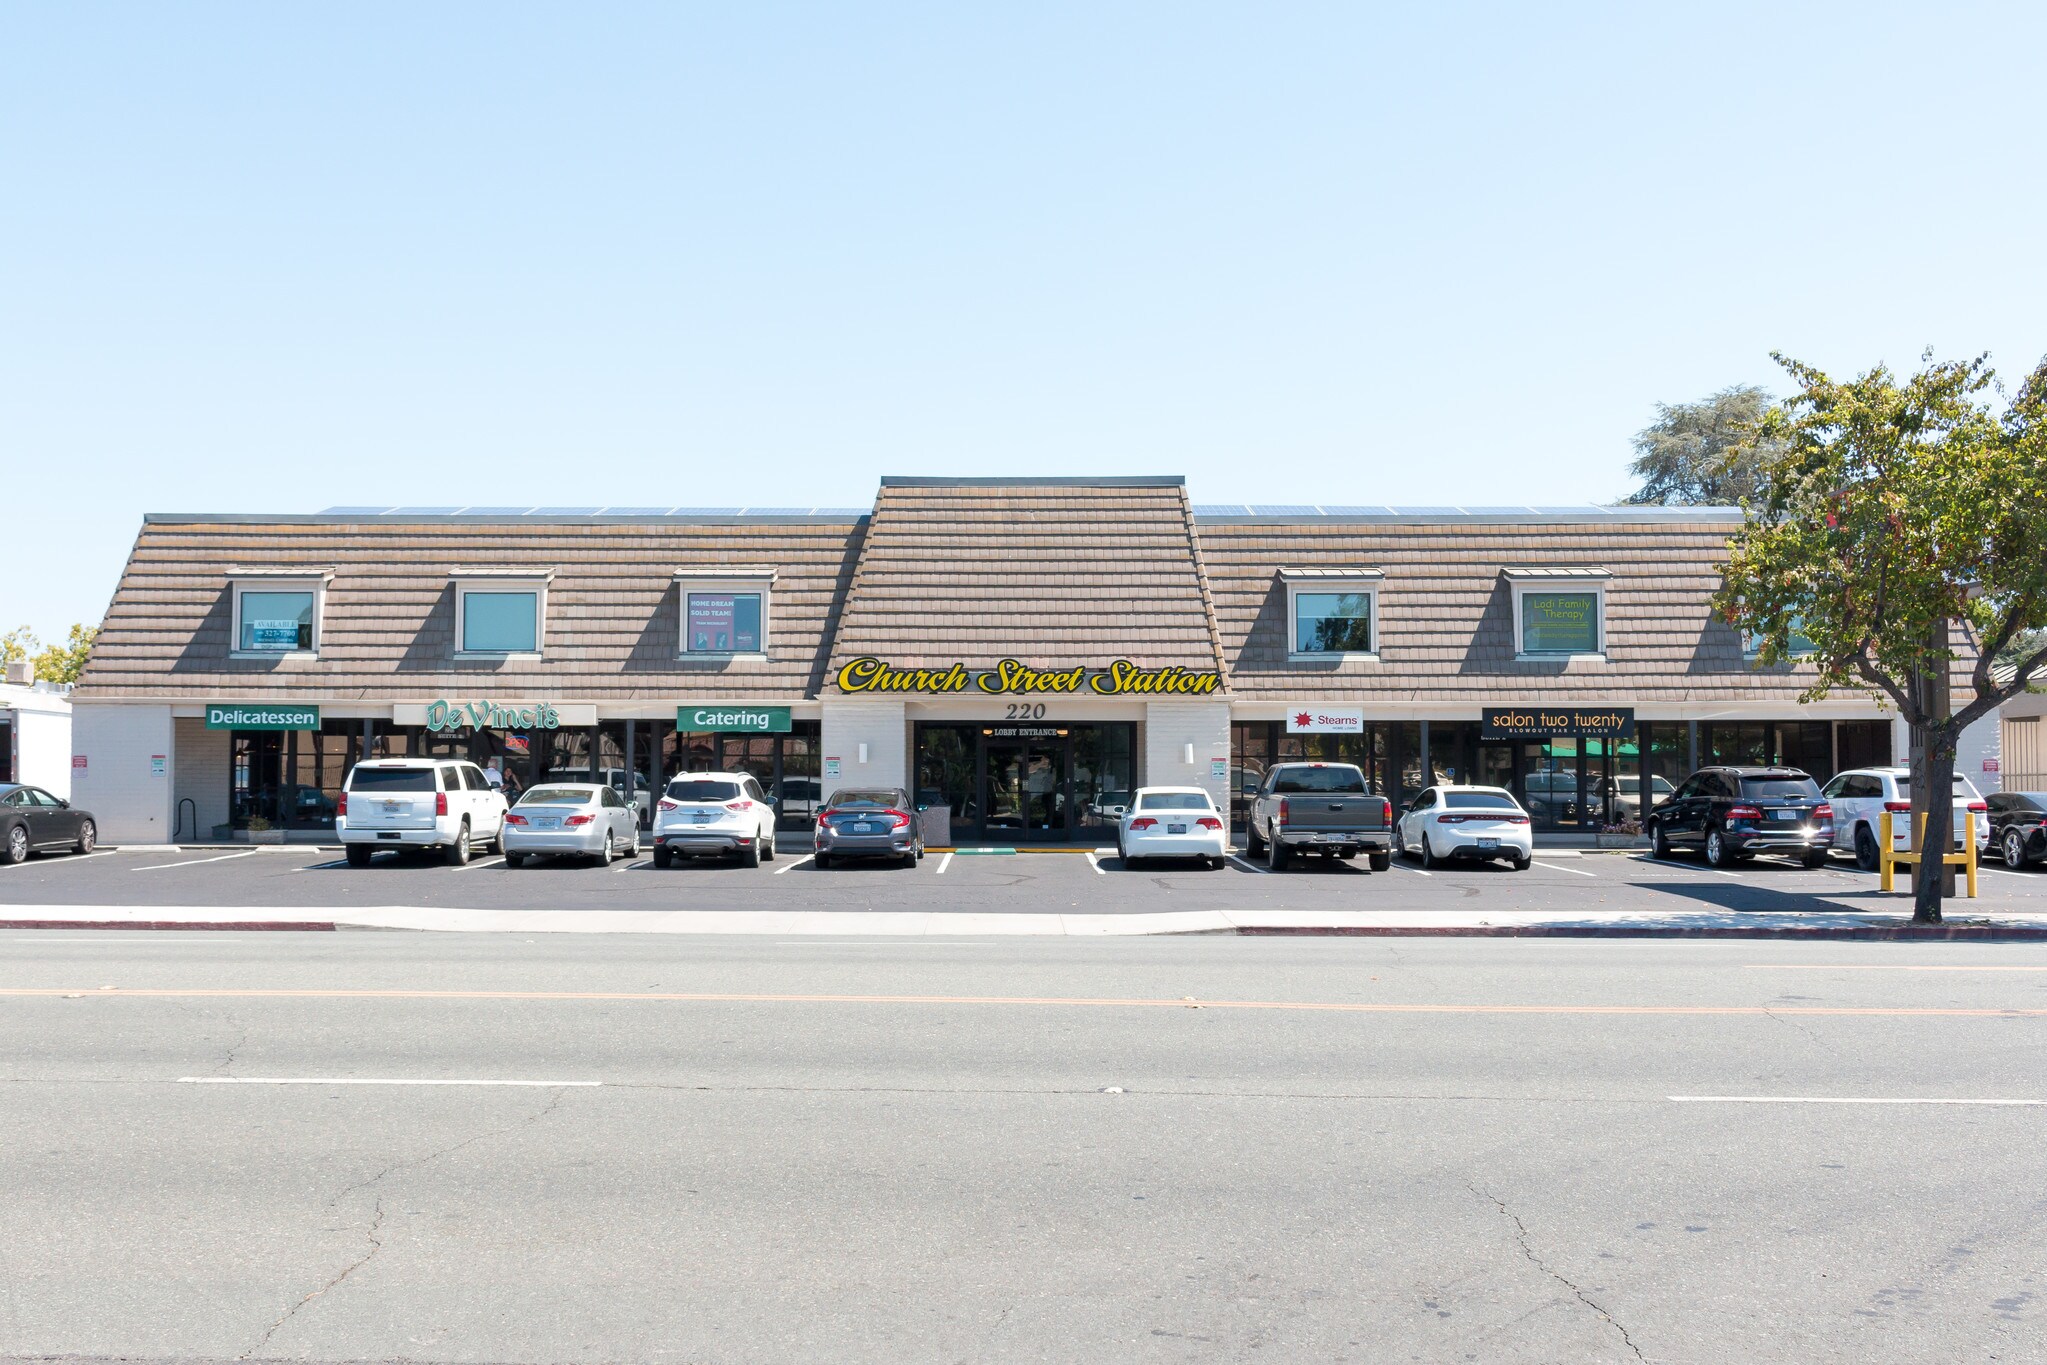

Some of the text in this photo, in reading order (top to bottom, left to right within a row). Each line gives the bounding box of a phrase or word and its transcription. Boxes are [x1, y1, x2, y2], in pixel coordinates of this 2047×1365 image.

[1533, 599, 1591, 610] Lodi Family
[1544, 609, 1584, 620] Therapy
[836, 657, 1221, 695] Church Street Station
[210, 710, 315, 724] Delicatessen
[1005, 703, 1046, 720] 220
[694, 710, 770, 730] Catering
[1318, 715, 1358, 725] Stearns
[1492, 711, 1625, 730] salon two twenty
[994, 728, 1057, 737] LOBBY ENTRANCE
[505, 737, 529, 749] OPEN
